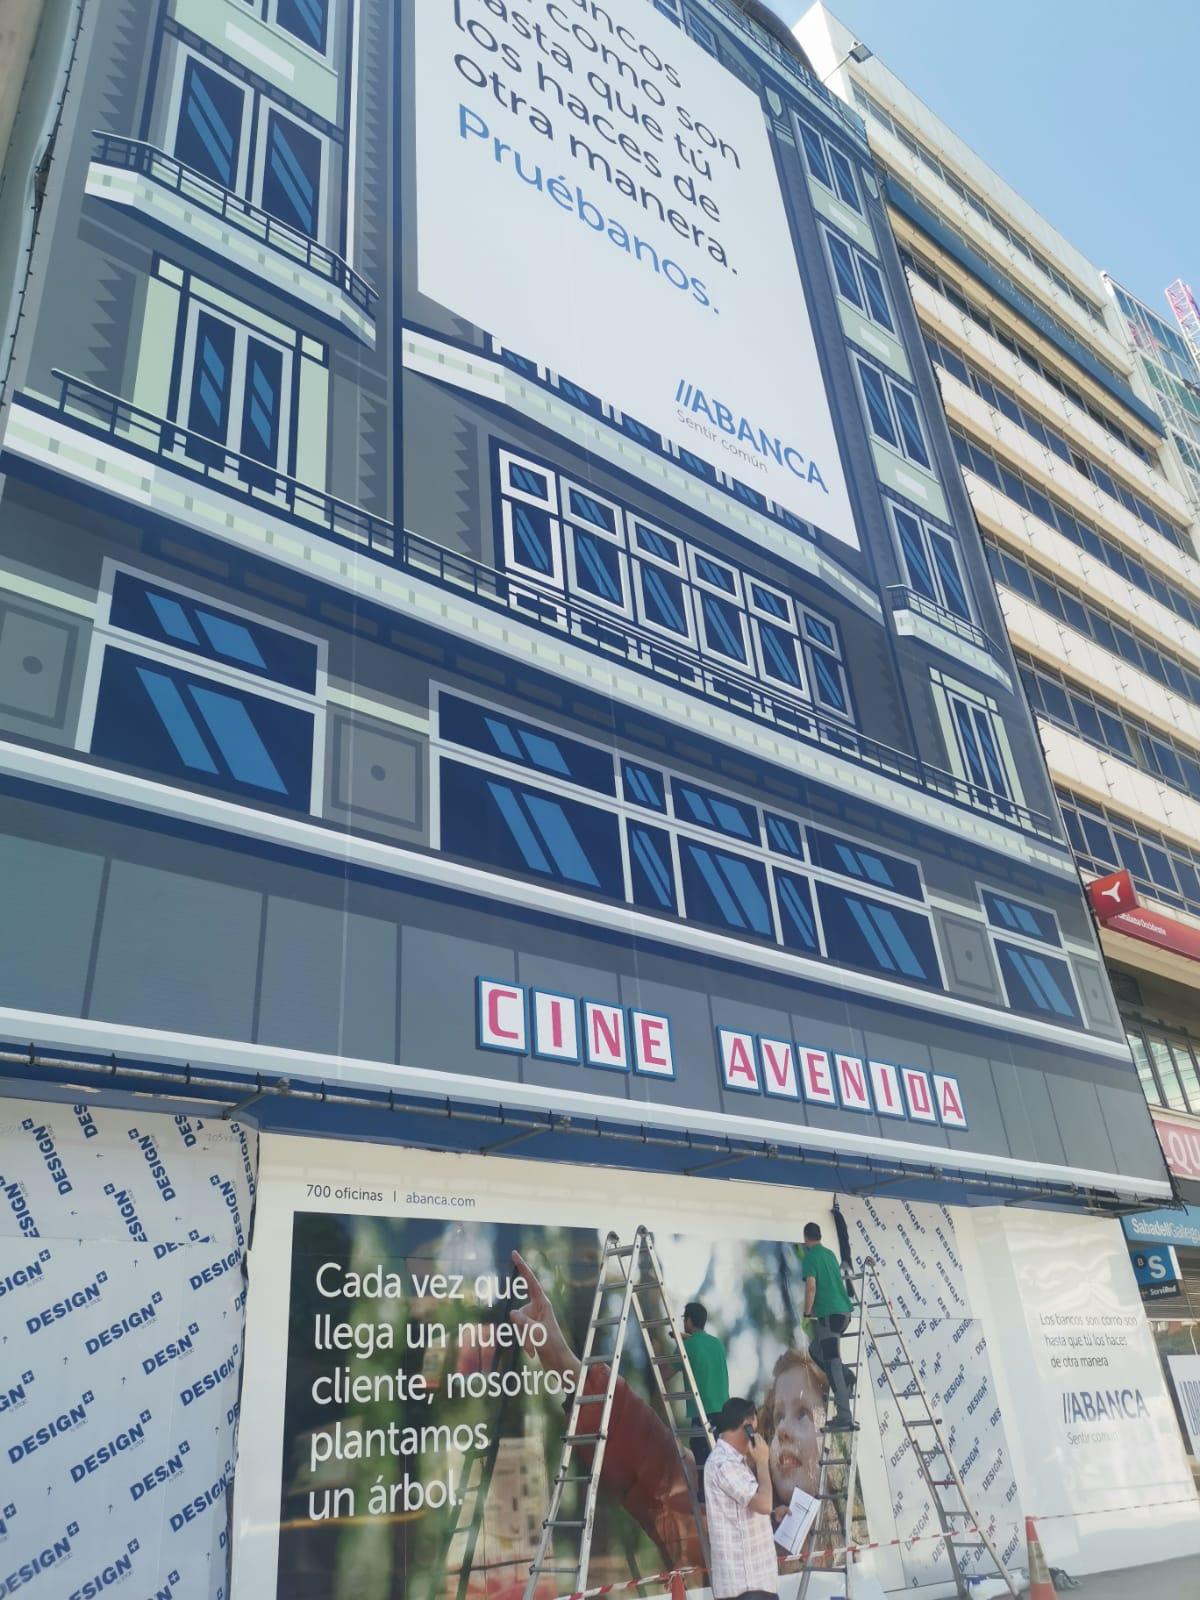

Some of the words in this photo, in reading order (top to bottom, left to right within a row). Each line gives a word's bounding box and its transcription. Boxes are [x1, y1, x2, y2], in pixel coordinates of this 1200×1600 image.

[453, 0, 522, 73] los
[537, 61, 662, 178] haces
[673, 174, 720, 222] de
[546, 3, 665, 106] como
[677, 106, 740, 169] son
[587, 72, 664, 142] que
[674, 133, 711, 181] tú
[454, 54, 553, 141] Otra
[569, 134, 738, 275] manera.
[459, 103, 720, 315] Pruébanos.
[676, 409, 718, 443] Sentir
[721, 438, 768, 474] común
[488, 988, 667, 1066] CINE
[728, 1037, 964, 1120] AVENIDA
[32, 1125, 73, 1196] DESIGN
[138, 1135, 176, 1202] DESIGN
[306, 1184, 331, 1199] 700
[335, 1186, 383, 1202] oficinas
[406, 1191, 476, 1208] abanca.com
[316, 1262, 401, 1299] Cada
[411, 1273, 465, 1299] vez
[474, 1273, 529, 1308] que
[1148, 1255, 1167, 1279] S
[26, 1282, 101, 1336] DESIGN
[85, 1303, 157, 1356] DESIGN
[314, 1313, 394, 1359] llega
[406, 1322, 446, 1349] un
[458, 1321, 548, 1348] nuevo
[1040, 1313, 1055, 1326] Los
[1055, 1313, 1084, 1326] bancos
[1086, 1316, 1098, 1326] son
[1101, 1315, 1122, 1326] como
[1124, 1315, 1137, 1326] son
[1044, 1333, 1066, 1346] hasta
[1068, 1336, 1082, 1349] que
[1092, 1333, 1105, 1346] los
[1106, 1333, 1128, 1346] haces
[1050, 1356, 1061, 1368] de
[1063, 1356, 1079, 1368] otra
[1080, 1356, 1109, 1368] manera
[180, 1355, 235, 1407] DESIGN
[311, 1366, 434, 1405] cliente,
[447, 1364, 576, 1399] nosotros
[8, 1404, 86, 1465] DESIGN
[70, 1423, 145, 1484] DESIGN
[310, 1421, 489, 1472] plantamos
[169, 1473, 229, 1533] DESIGN
[308, 1486, 354, 1521] un
[368, 1468, 463, 1515] árbol.
